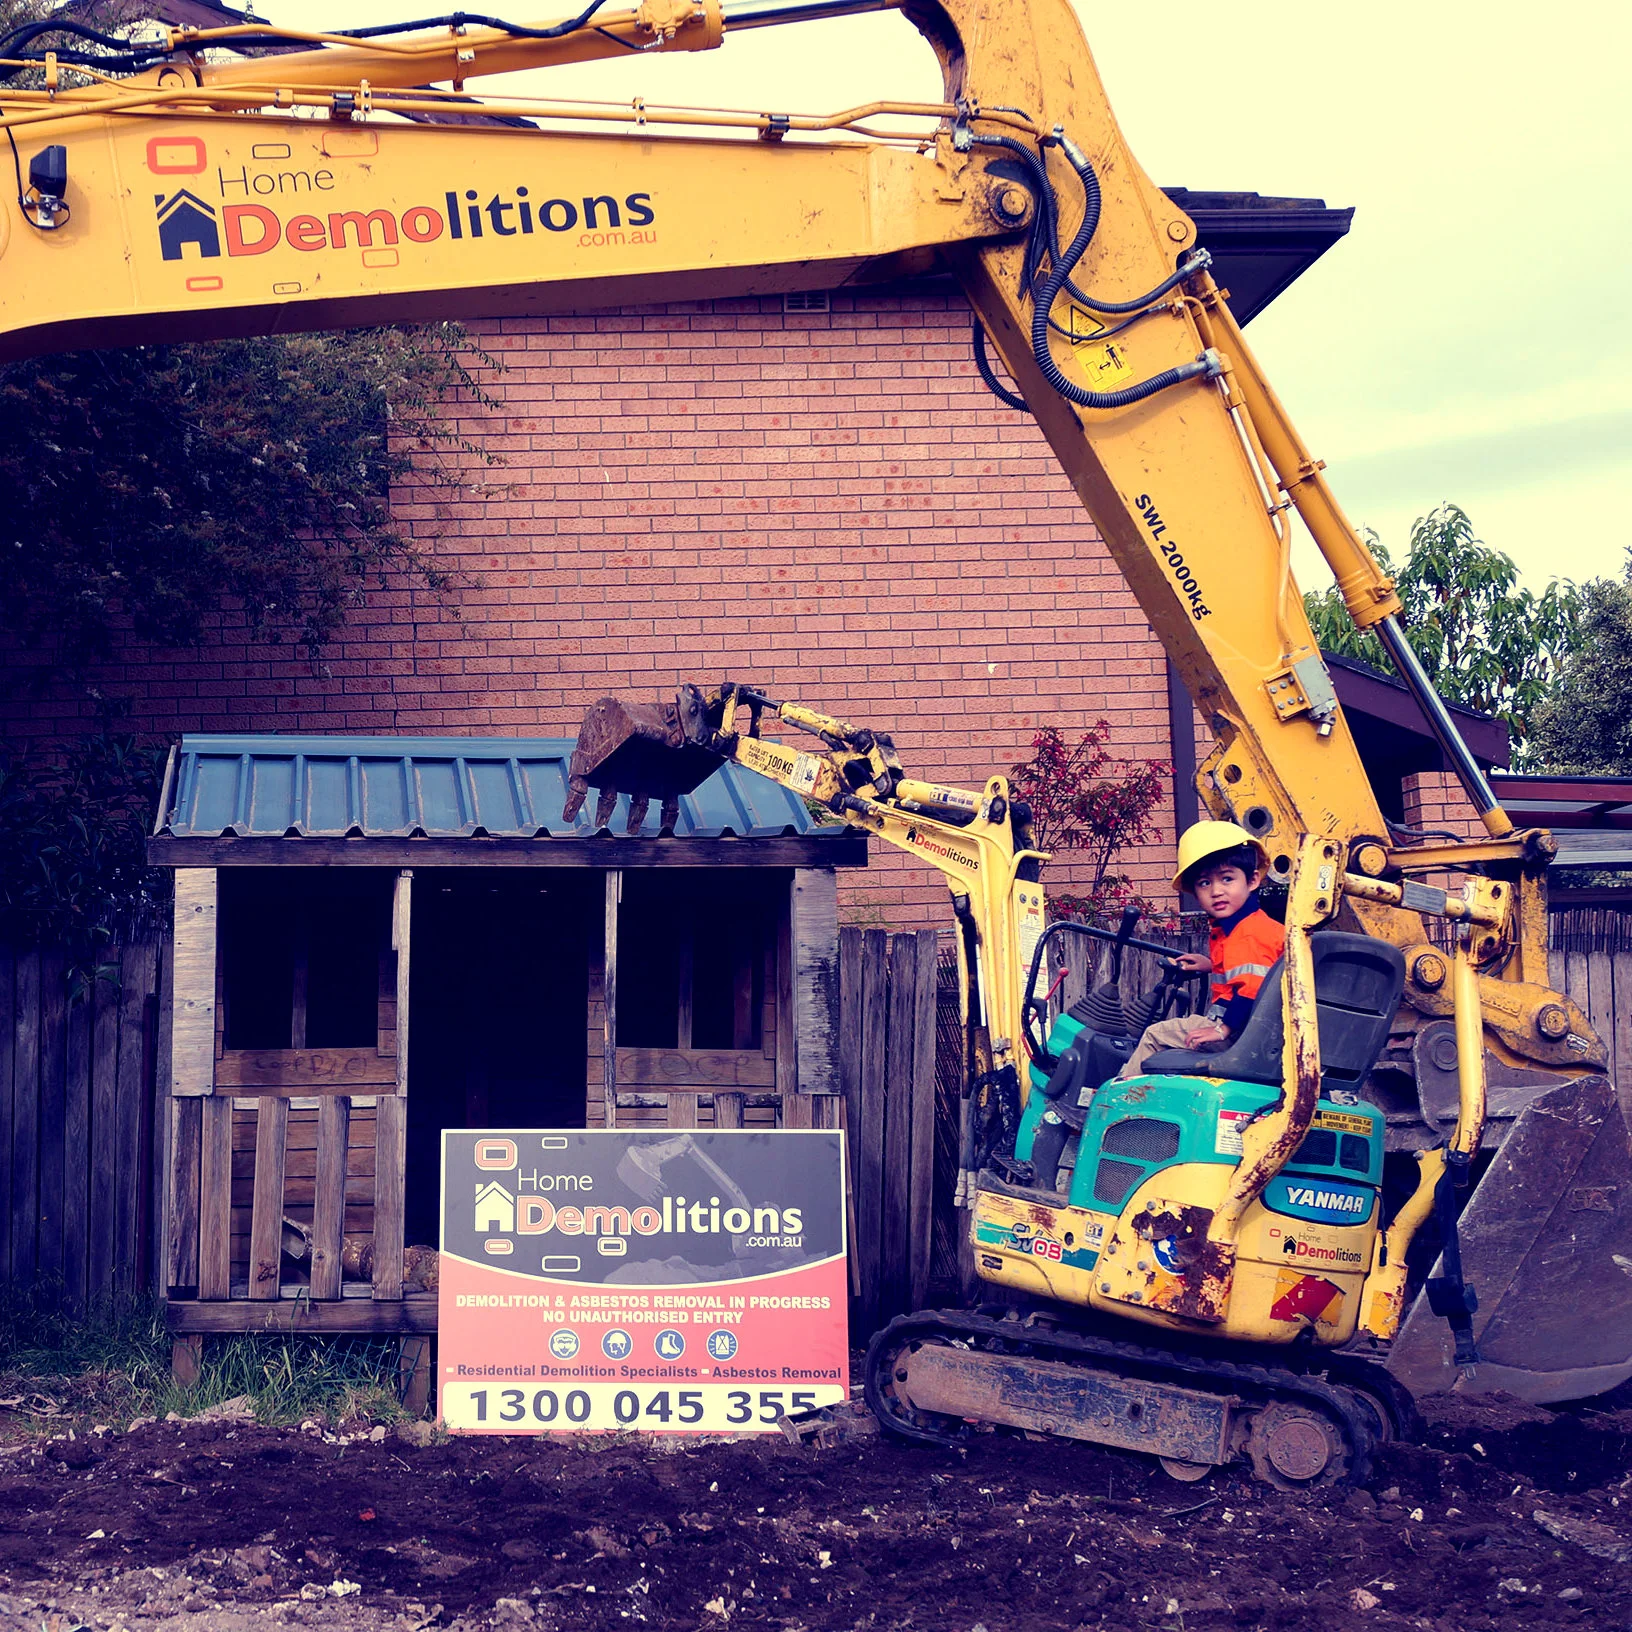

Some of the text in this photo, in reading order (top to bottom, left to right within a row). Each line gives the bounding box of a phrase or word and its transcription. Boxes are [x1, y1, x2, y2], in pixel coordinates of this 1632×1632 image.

[218, 166, 335, 198] Home
[222, 186, 657, 258] Demolitions
[576, 228, 658, 249] .com.au
[1135, 494, 1212, 620] SWL 2000kg
[915, 833, 979, 870] Demolitions
[518, 1168, 593, 1191] Home
[1286, 1186, 1365, 1213] YANMAR
[516, 1196, 803, 1236] Demolitions
[745, 1234, 802, 1248] .com.au
[1298, 1231, 1321, 1244] Home
[1296, 1241, 1362, 1263] Demolitions
[456, 1294, 831, 1309] DEMOLITION & ASBESTOS REMOVAL IN PROGRESS
[543, 1310, 744, 1324] NO UNAUTHORISED ENTRY
[457, 1364, 842, 1379] Residential Demolition Specialists Asbestos Removal
[470, 1389, 592, 1422] 1300
[613, 1390, 704, 1424] 045
